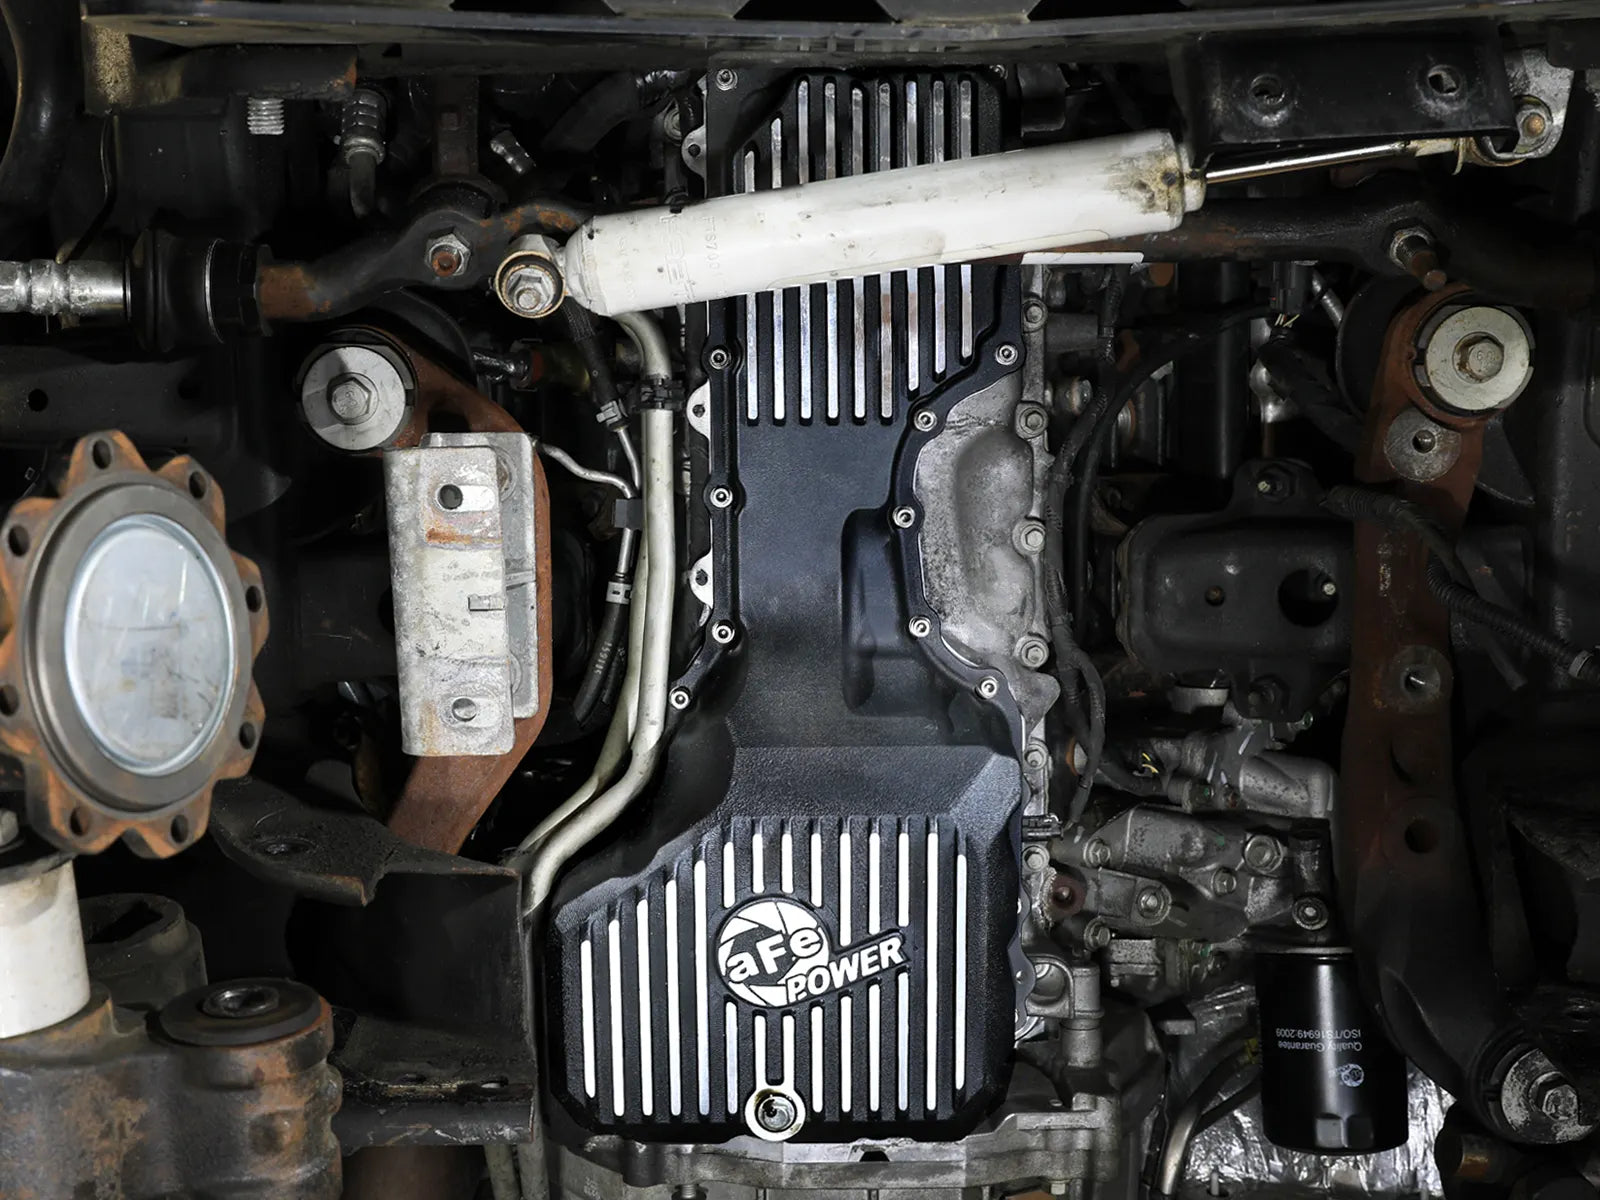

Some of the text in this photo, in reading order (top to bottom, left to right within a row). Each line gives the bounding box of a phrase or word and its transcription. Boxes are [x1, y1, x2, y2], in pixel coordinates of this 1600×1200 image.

[726, 927, 823, 984] aFe
[786, 936, 905, 1004] POWER
[1278, 1040, 1363, 1053] Quality Guarantee
